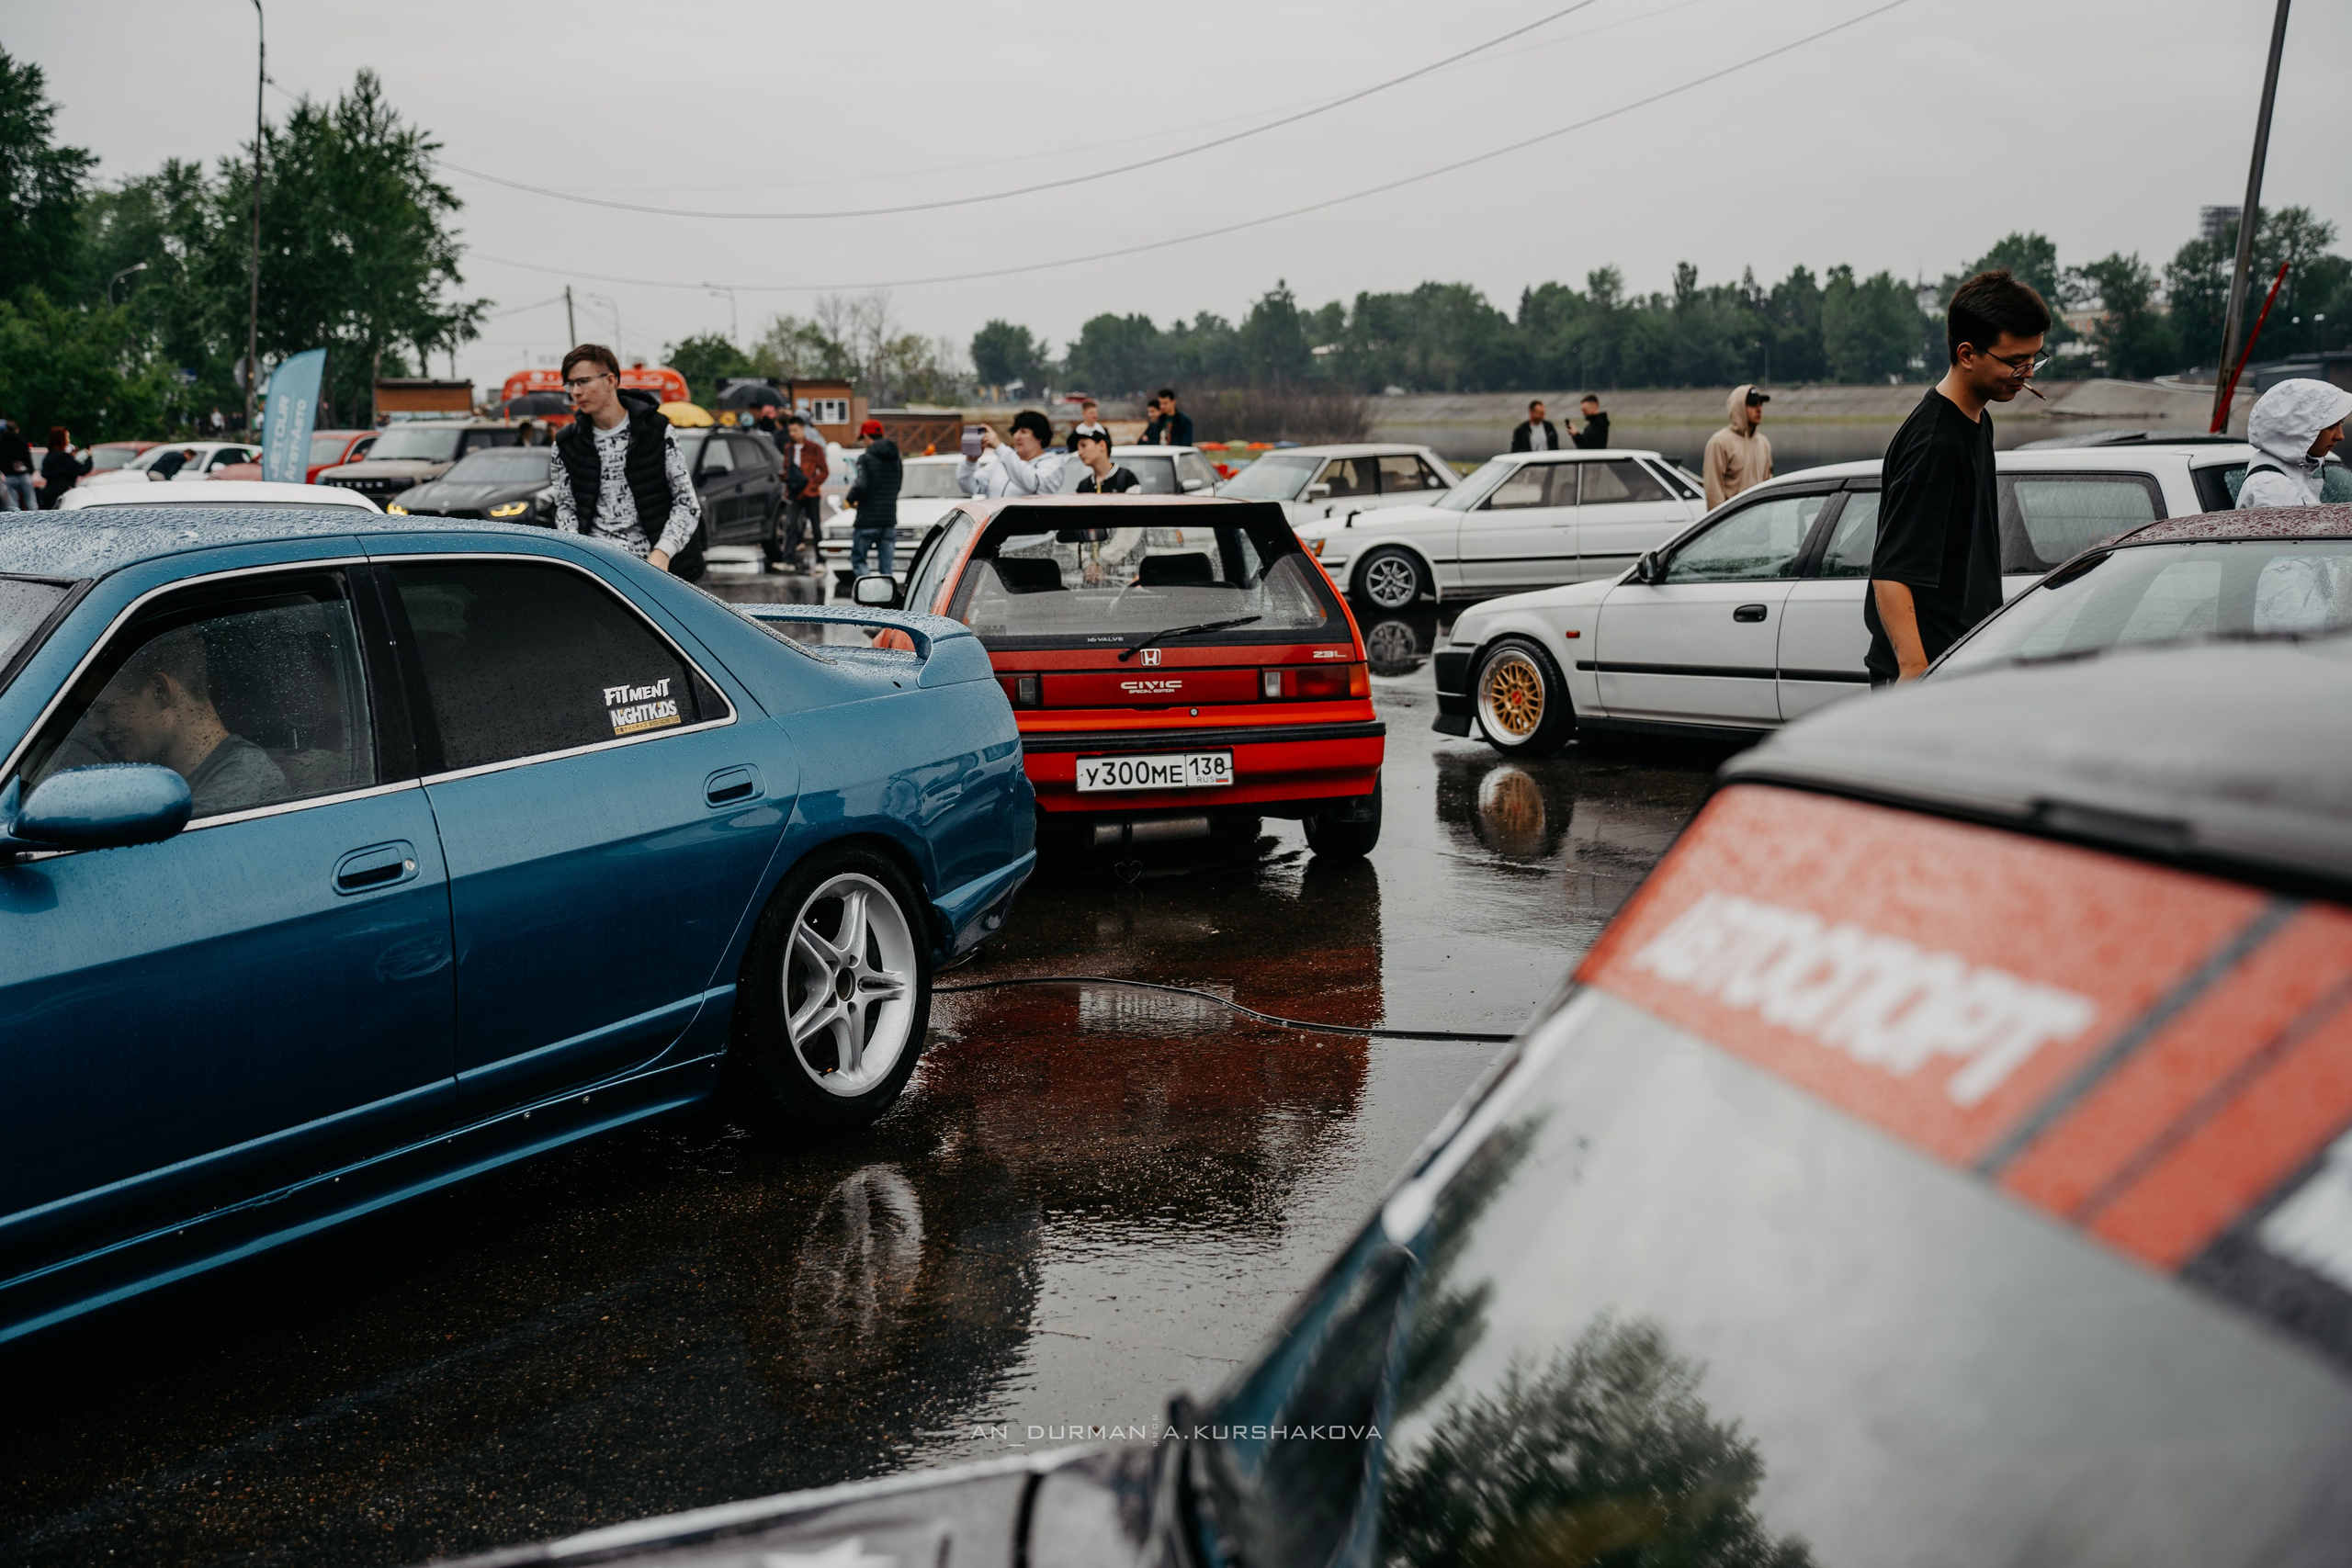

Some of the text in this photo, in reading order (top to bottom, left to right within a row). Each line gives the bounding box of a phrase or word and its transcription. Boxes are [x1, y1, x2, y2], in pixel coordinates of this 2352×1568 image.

[269, 394, 290, 479] JETOUR
[1120, 681, 1182, 690] CIVIC
[1086, 757, 1226, 786] У300МЕ 138
